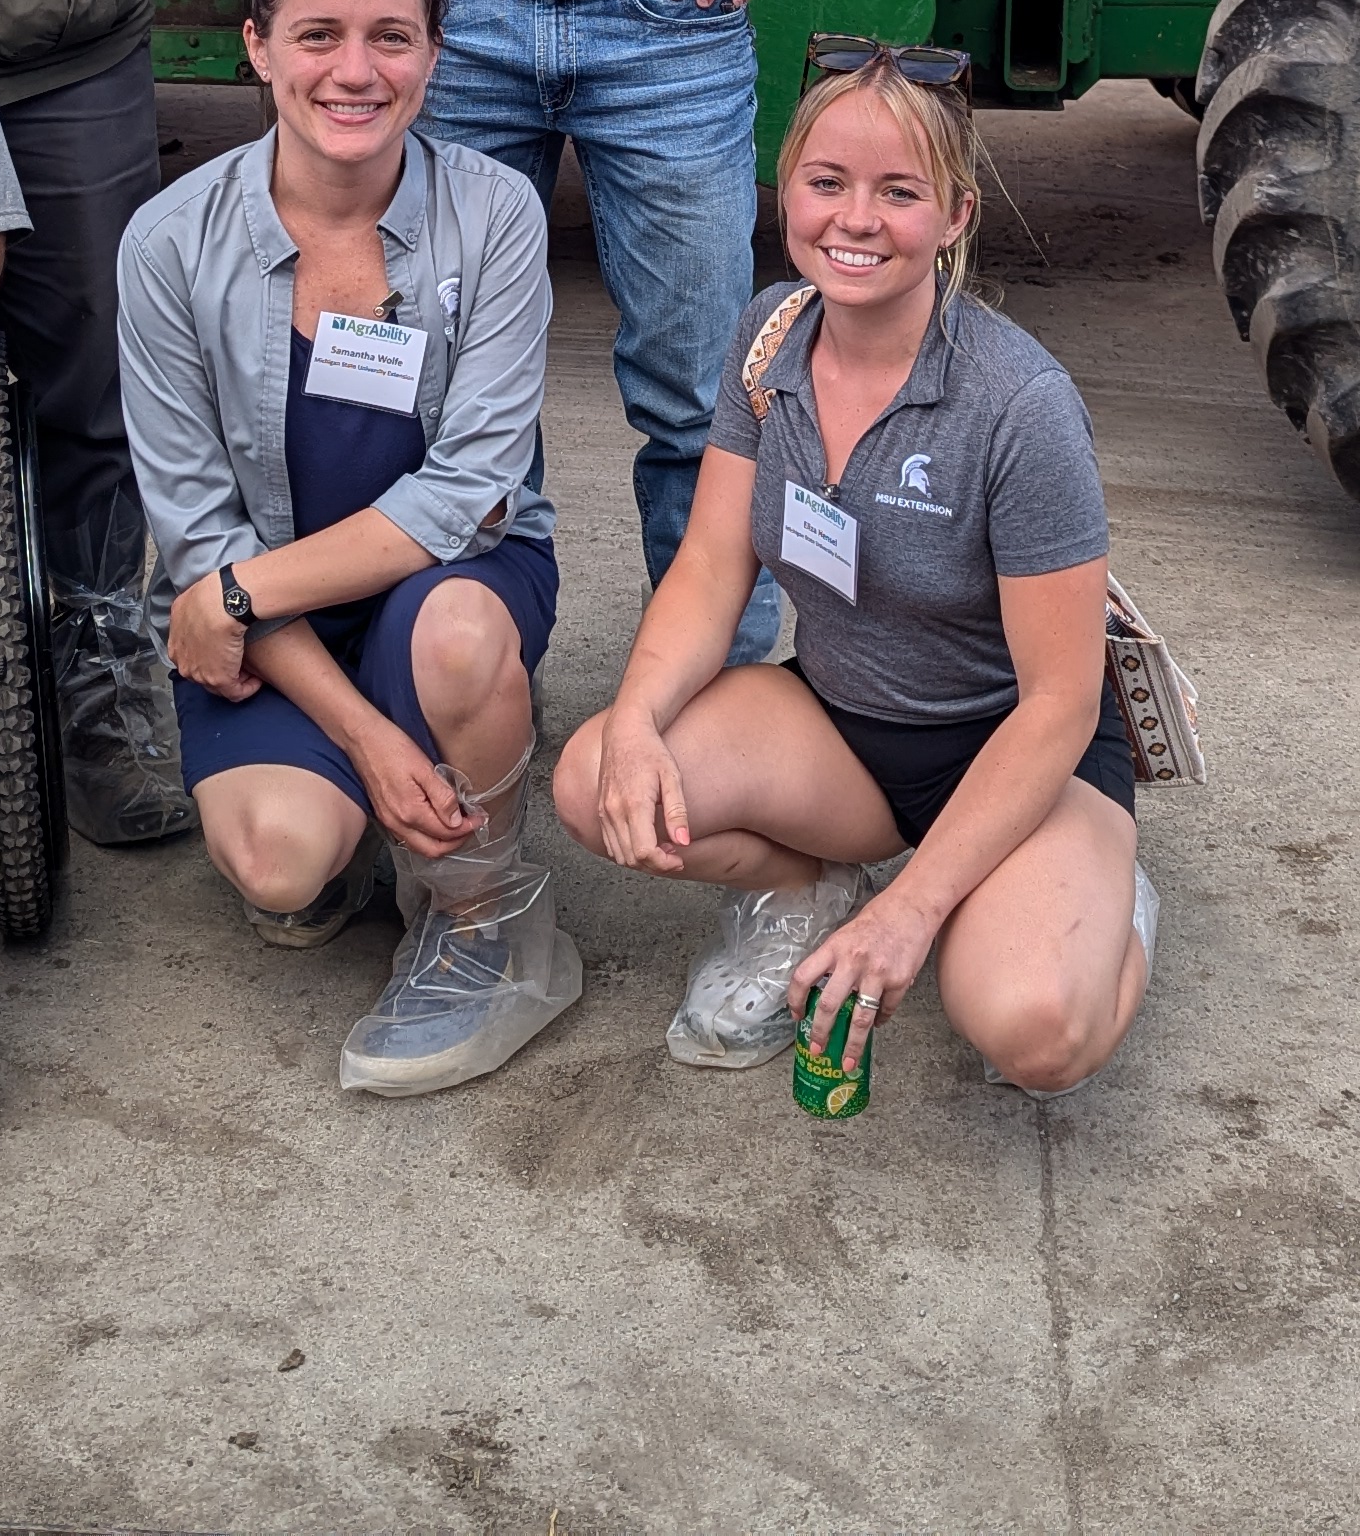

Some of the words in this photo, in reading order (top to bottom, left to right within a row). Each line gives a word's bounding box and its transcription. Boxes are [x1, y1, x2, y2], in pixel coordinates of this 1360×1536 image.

[346, 319, 412, 346] AgrAbility
[330, 345, 376, 362] Samantha
[378, 354, 404, 367] Wolfe
[314, 357, 341, 366] Michigan
[357, 364, 386, 376] University
[387, 370, 415, 381] Extension
[804, 493, 847, 531] AgrAbility
[875, 492, 897, 505] MSU
[897, 498, 953, 517] EXTENSION
[803, 520, 817, 535] Eliza
[807, 1062, 843, 1079] soda
